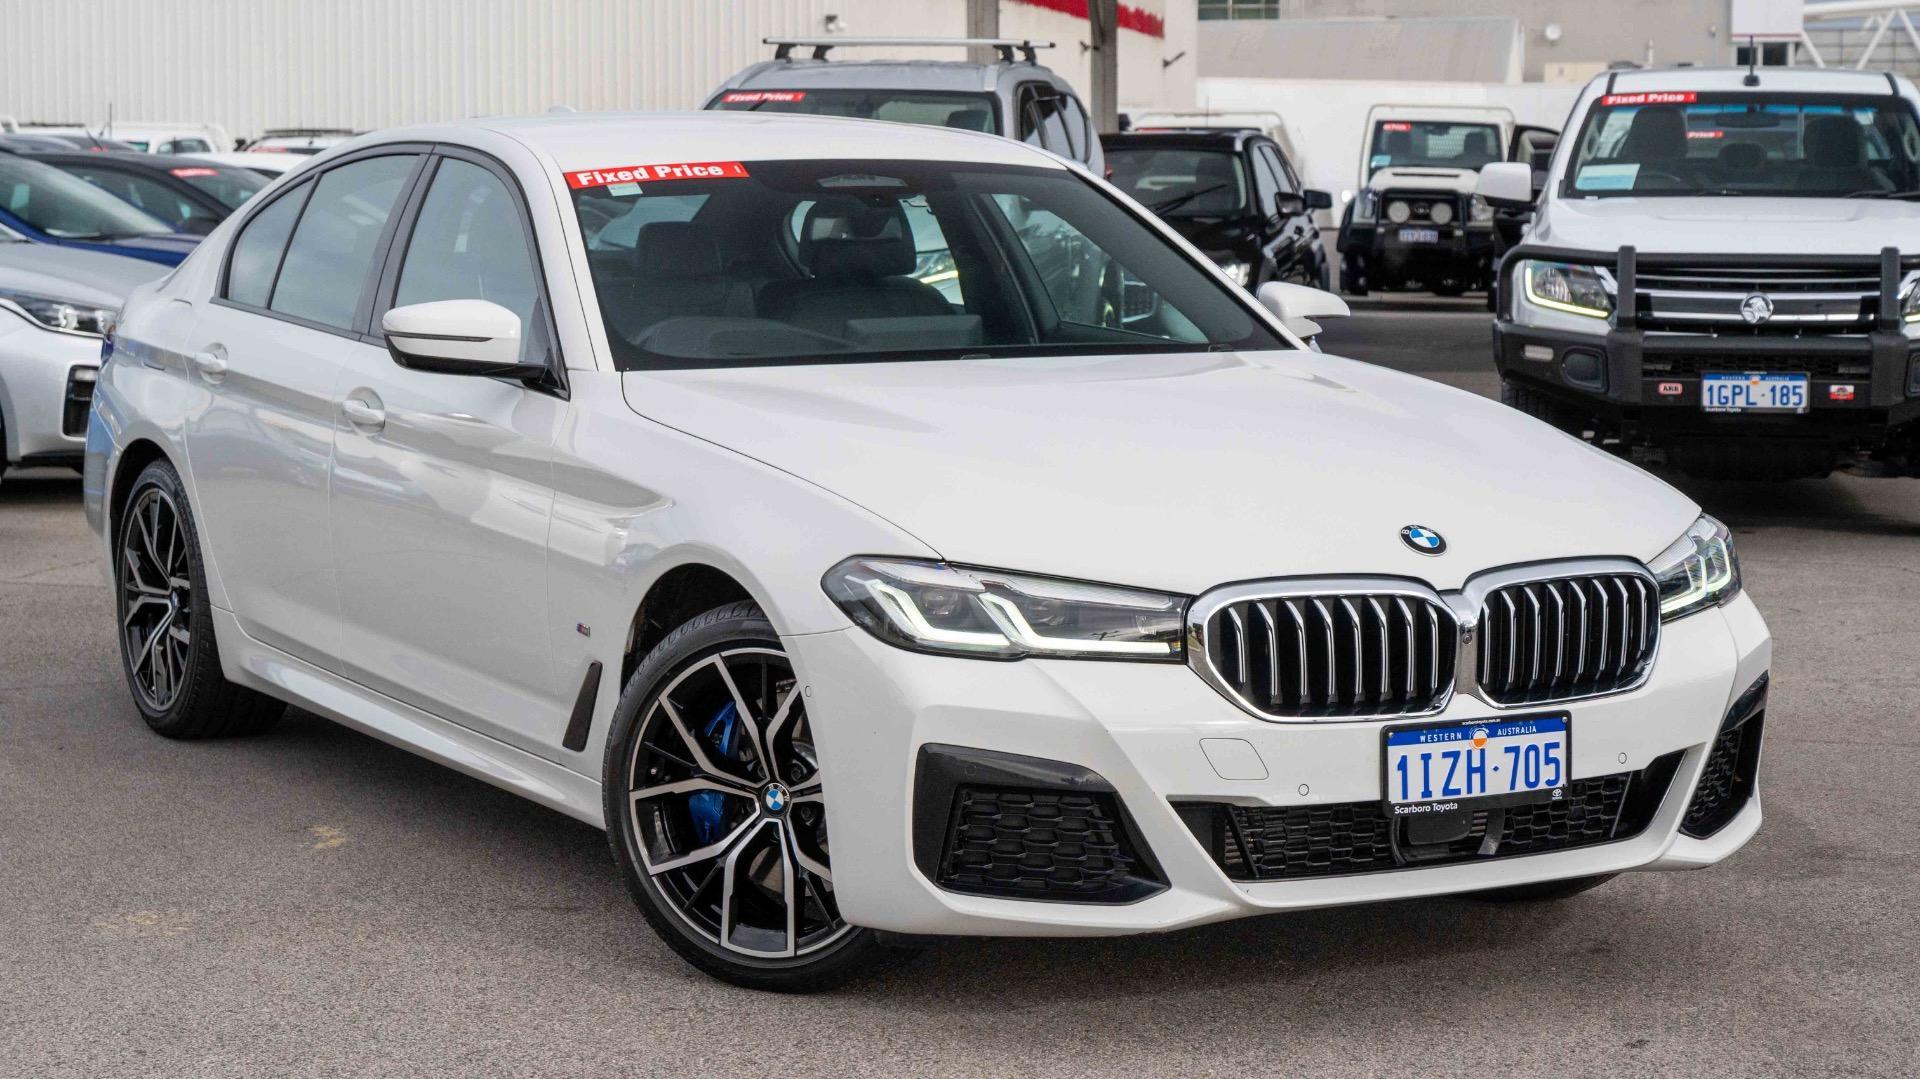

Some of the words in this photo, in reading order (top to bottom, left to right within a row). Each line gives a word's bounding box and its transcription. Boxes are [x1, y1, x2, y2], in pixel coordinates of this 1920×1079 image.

[1608, 94, 1645, 105] Fixed
[1648, 92, 1684, 103] Price
[576, 165, 650, 186] Fixed
[653, 164, 724, 178] Price
[1420, 732, 1462, 742] WESTERN
[1497, 725, 1537, 736] AUSTRALIA
[1394, 804, 1431, 815] Scarboro
[1432, 801, 1458, 812] Toyota
